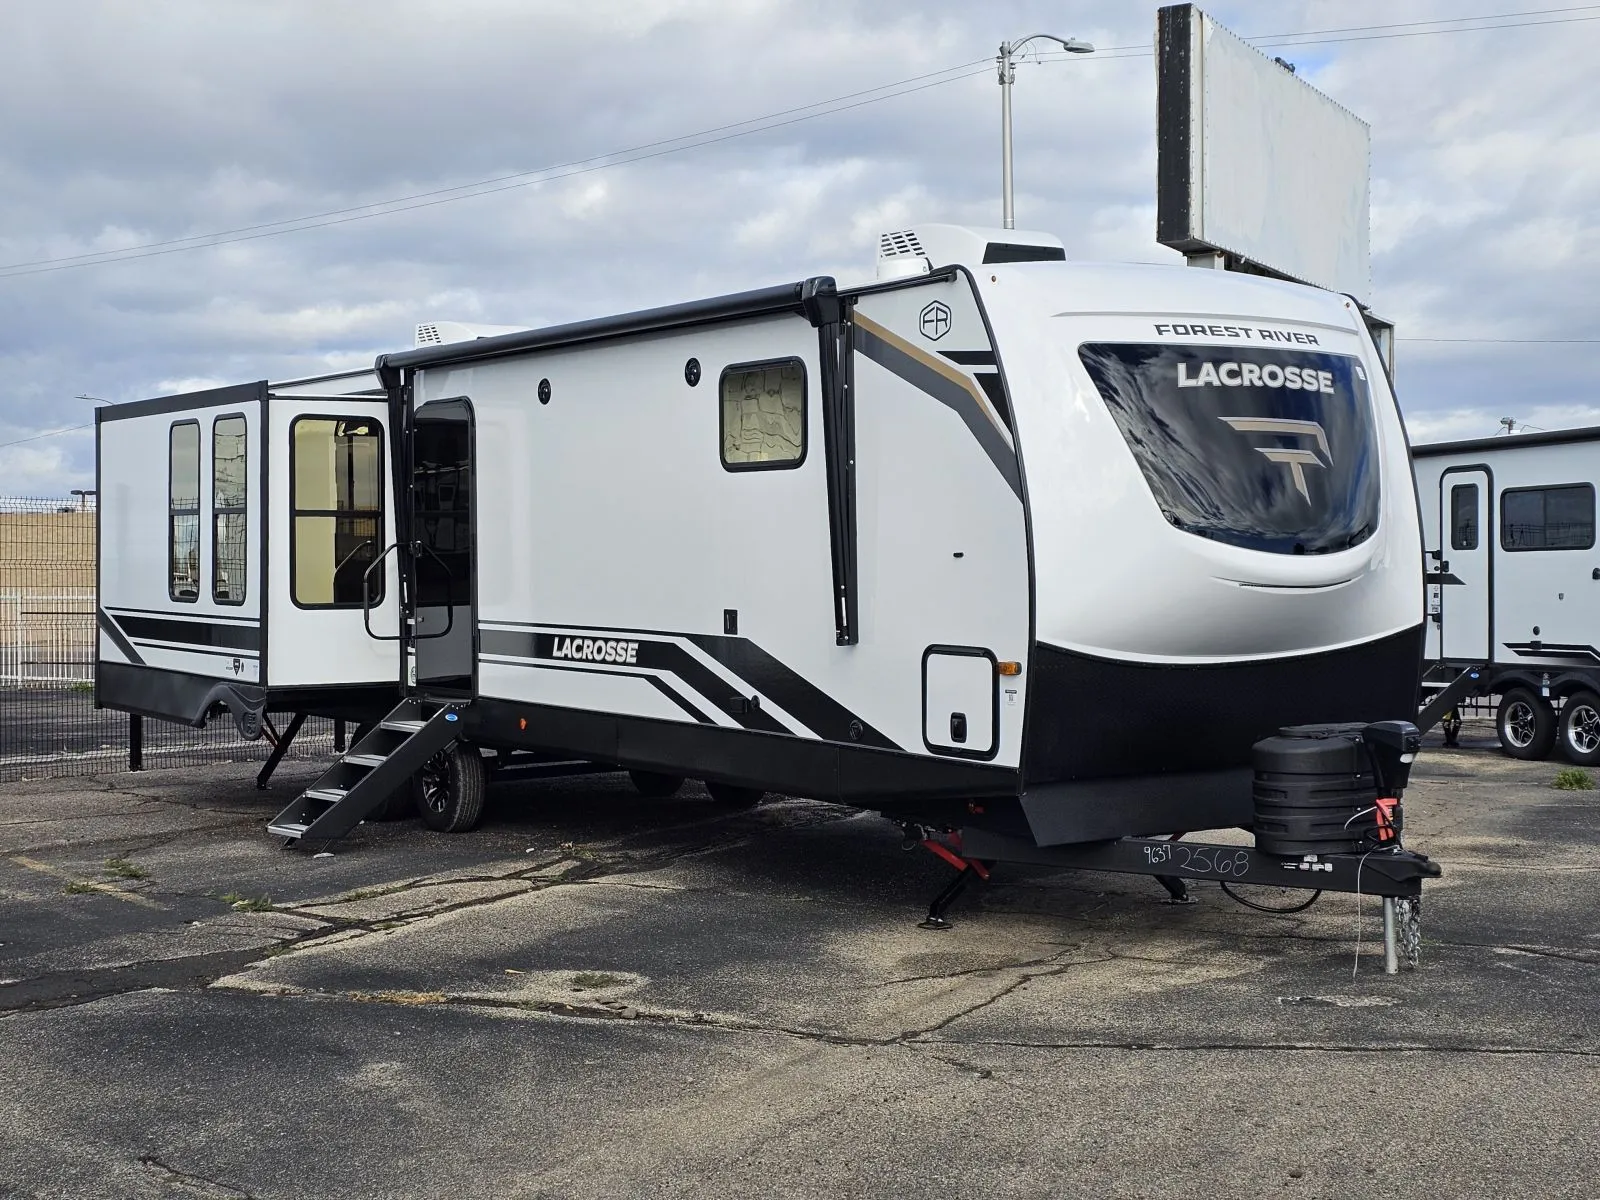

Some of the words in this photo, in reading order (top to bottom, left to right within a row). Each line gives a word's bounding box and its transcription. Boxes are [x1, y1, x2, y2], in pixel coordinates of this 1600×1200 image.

[1154, 324, 1252, 339] FOREST
[1258, 328, 1320, 346] RIVER
[1177, 361, 1335, 394] LACROSSE
[552, 636, 639, 664] LACROSSE
[1143, 844, 1172, 865] 9637
[1176, 846, 1249, 877] 2568
